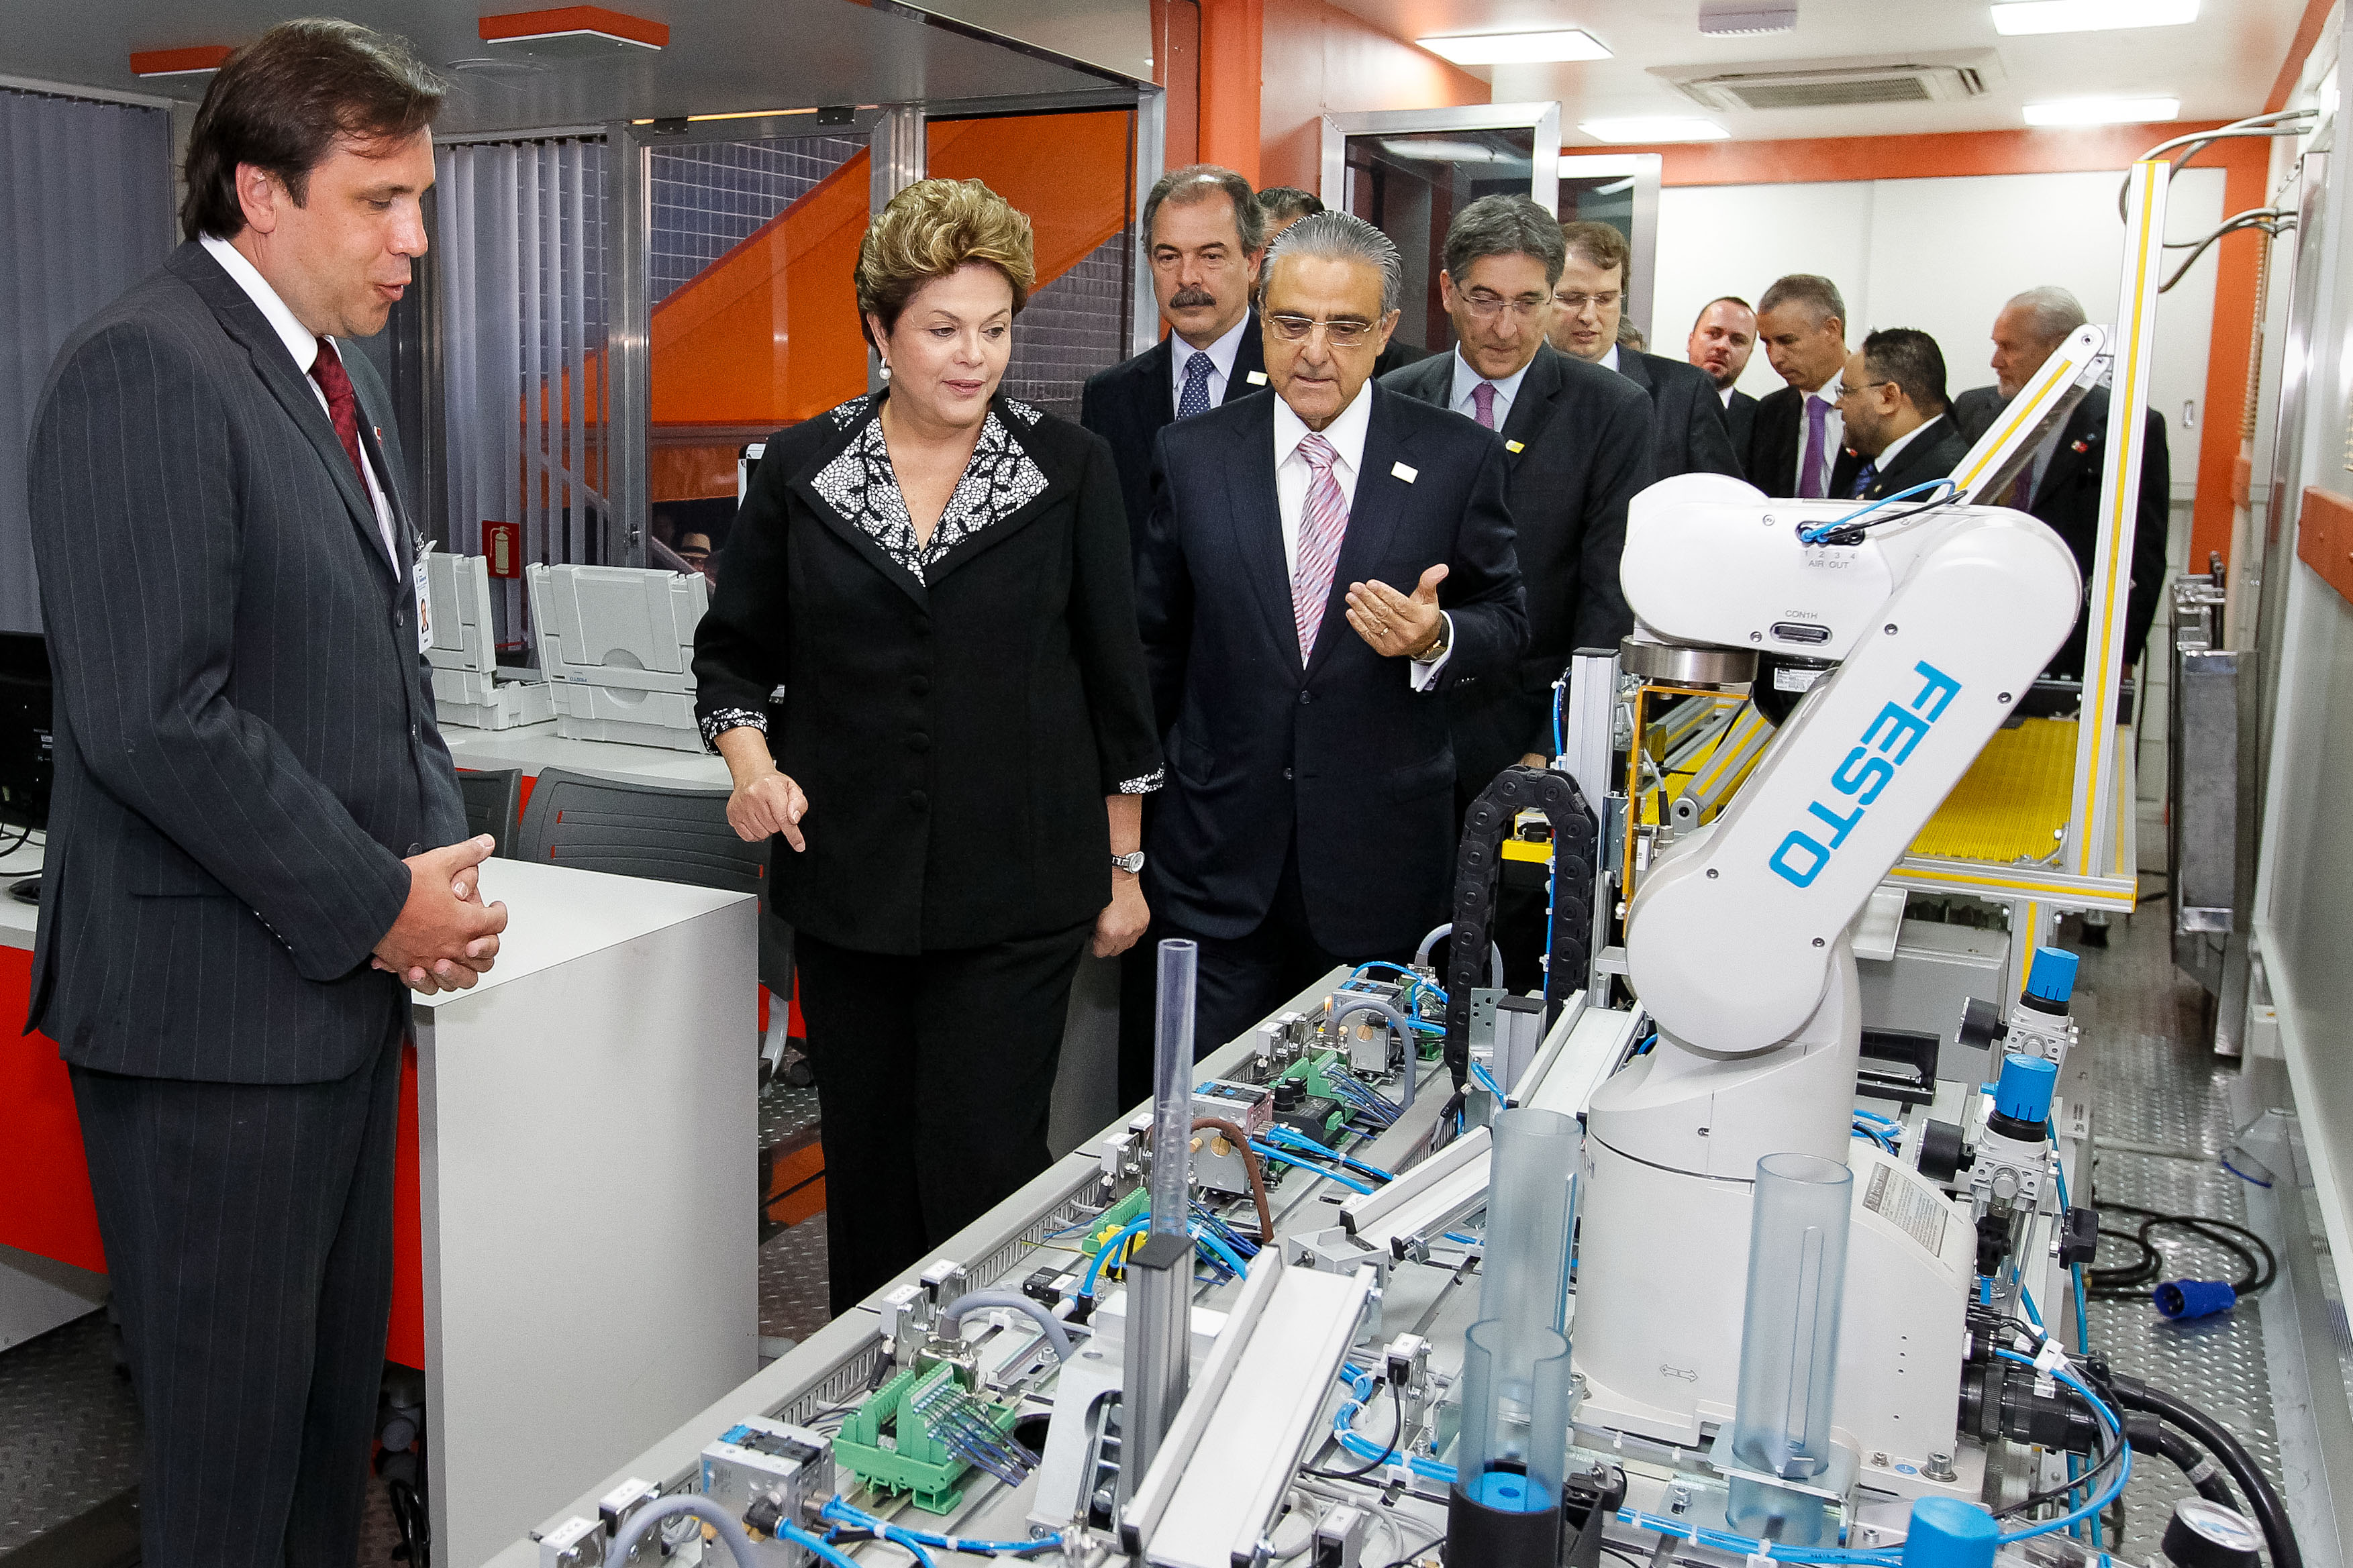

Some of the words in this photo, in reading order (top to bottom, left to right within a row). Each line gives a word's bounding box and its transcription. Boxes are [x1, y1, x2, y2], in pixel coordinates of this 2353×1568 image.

[1818, 550, 1825, 558] 2
[1808, 560, 1825, 568] AIR
[1829, 560, 1850, 569] OUT
[1768, 660, 1962, 888] FESTO
